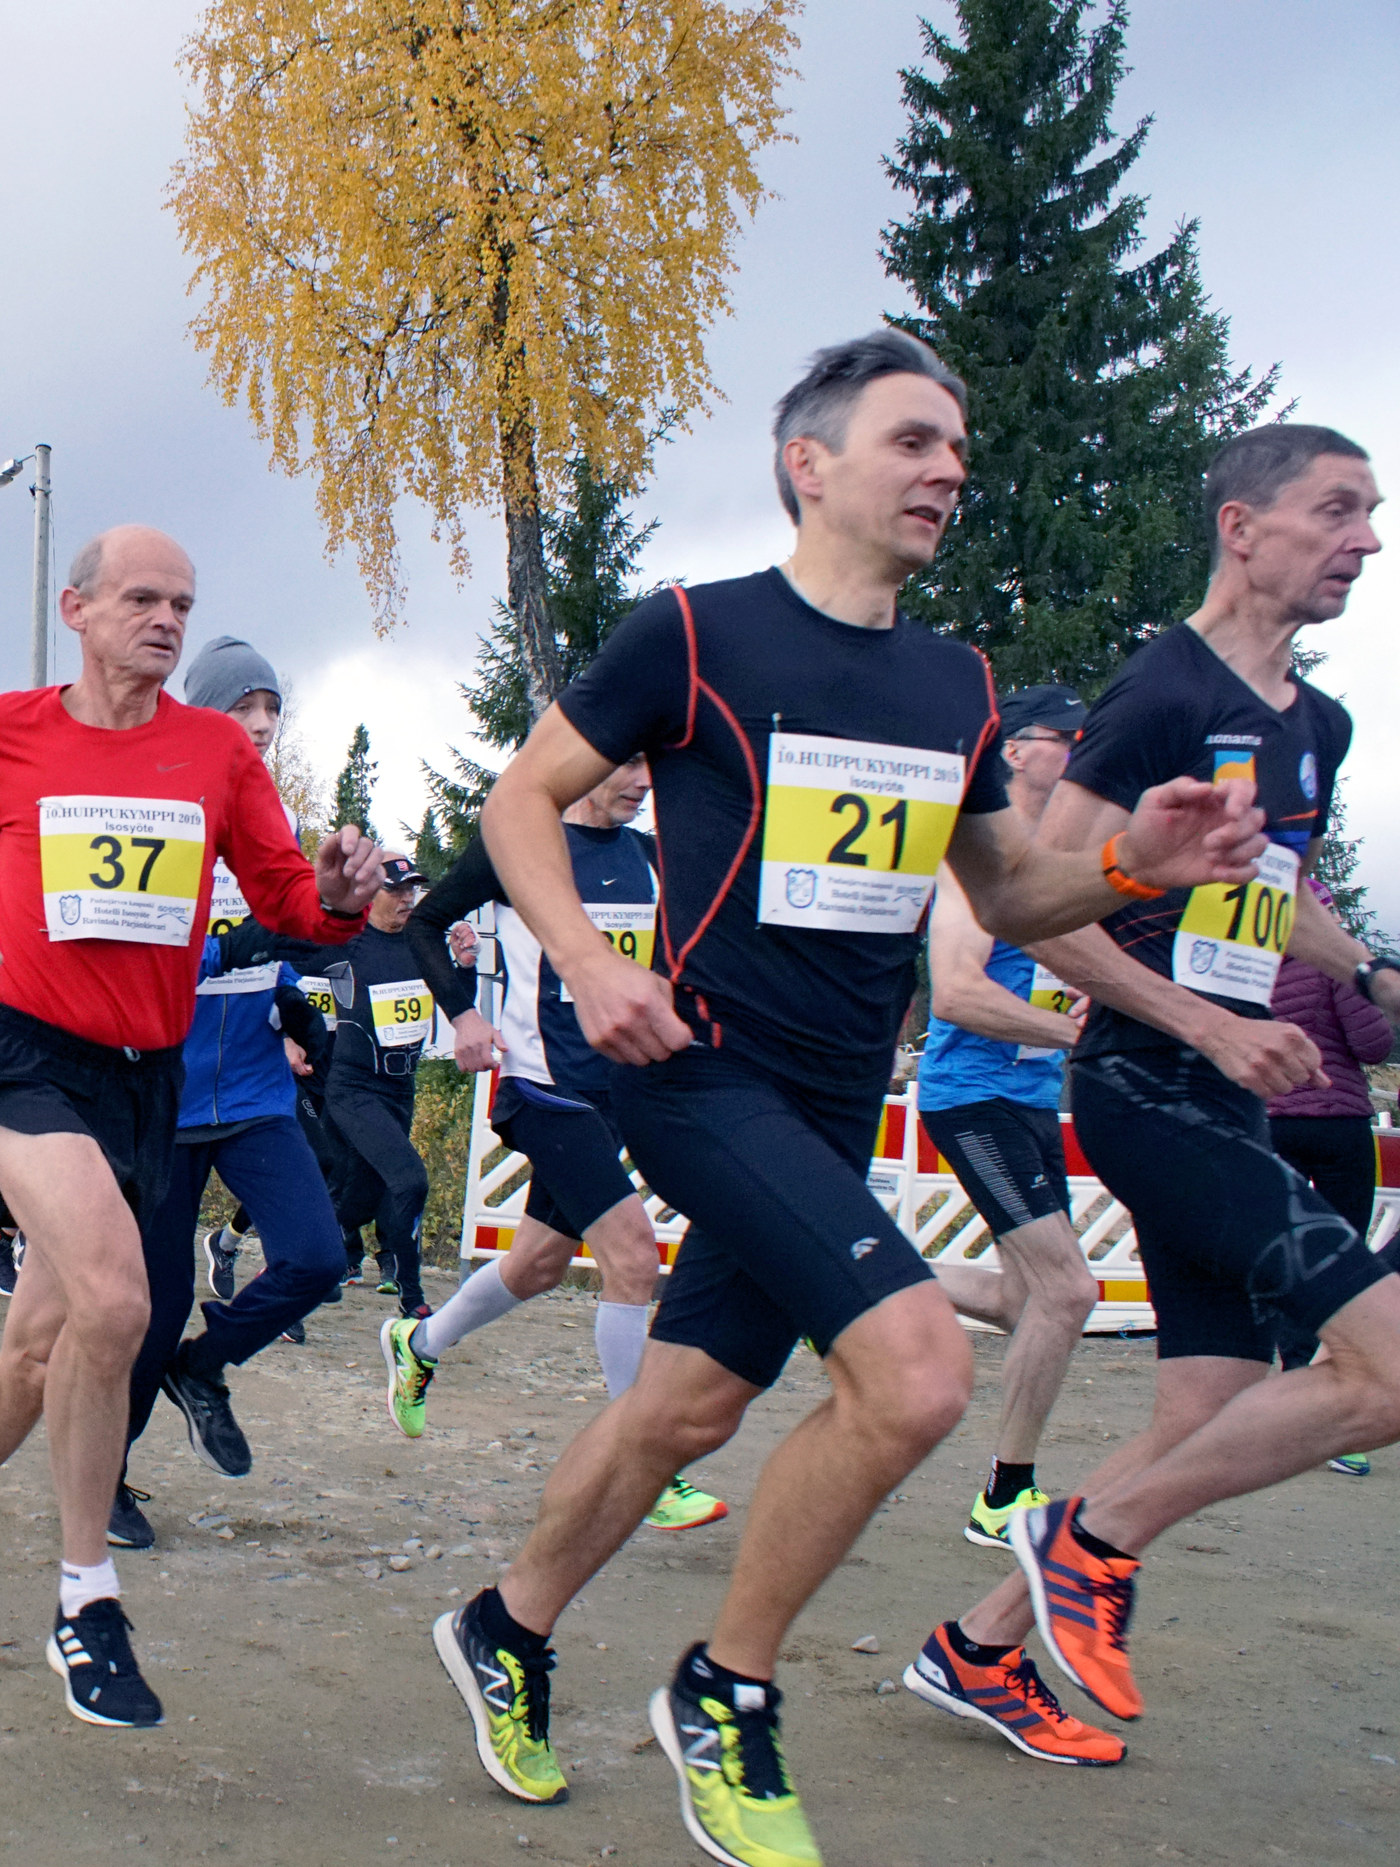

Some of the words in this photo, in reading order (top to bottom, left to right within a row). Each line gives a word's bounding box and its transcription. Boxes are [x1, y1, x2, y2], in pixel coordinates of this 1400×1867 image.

[776, 750, 931, 780] 10.HUIPPUKYMPPI
[46, 806, 176, 823] 10.HUIPPUKYMPPI
[179, 813, 202, 826] 2019
[105, 821, 154, 834] Isosyöte
[826, 792, 909, 871] 21
[89, 834, 166, 892] 37
[306, 992, 332, 1014] 58
[393, 997, 421, 1024] 59
